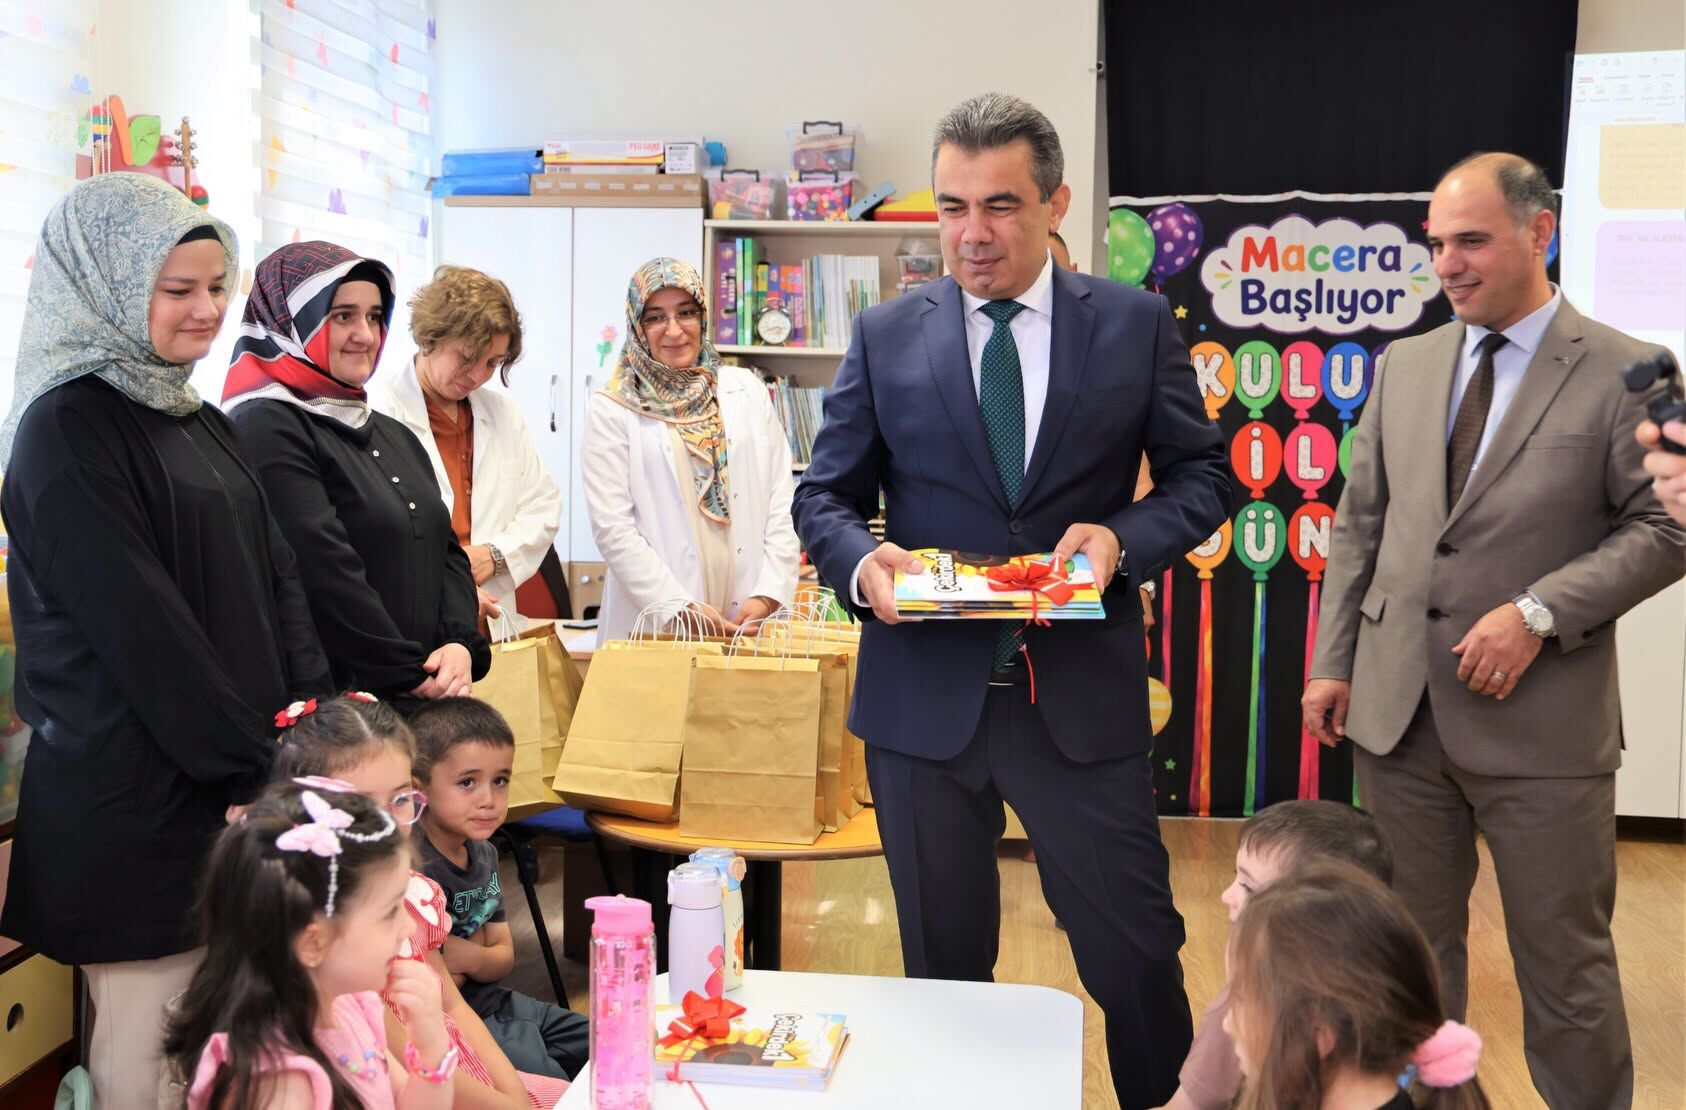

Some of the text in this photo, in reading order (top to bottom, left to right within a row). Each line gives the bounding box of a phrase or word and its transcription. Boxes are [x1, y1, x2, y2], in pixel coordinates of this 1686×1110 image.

[1240, 235, 1402, 273] Macera
[1240, 278, 1406, 325] Başlıyor
[1192, 352, 1384, 399] KULU
